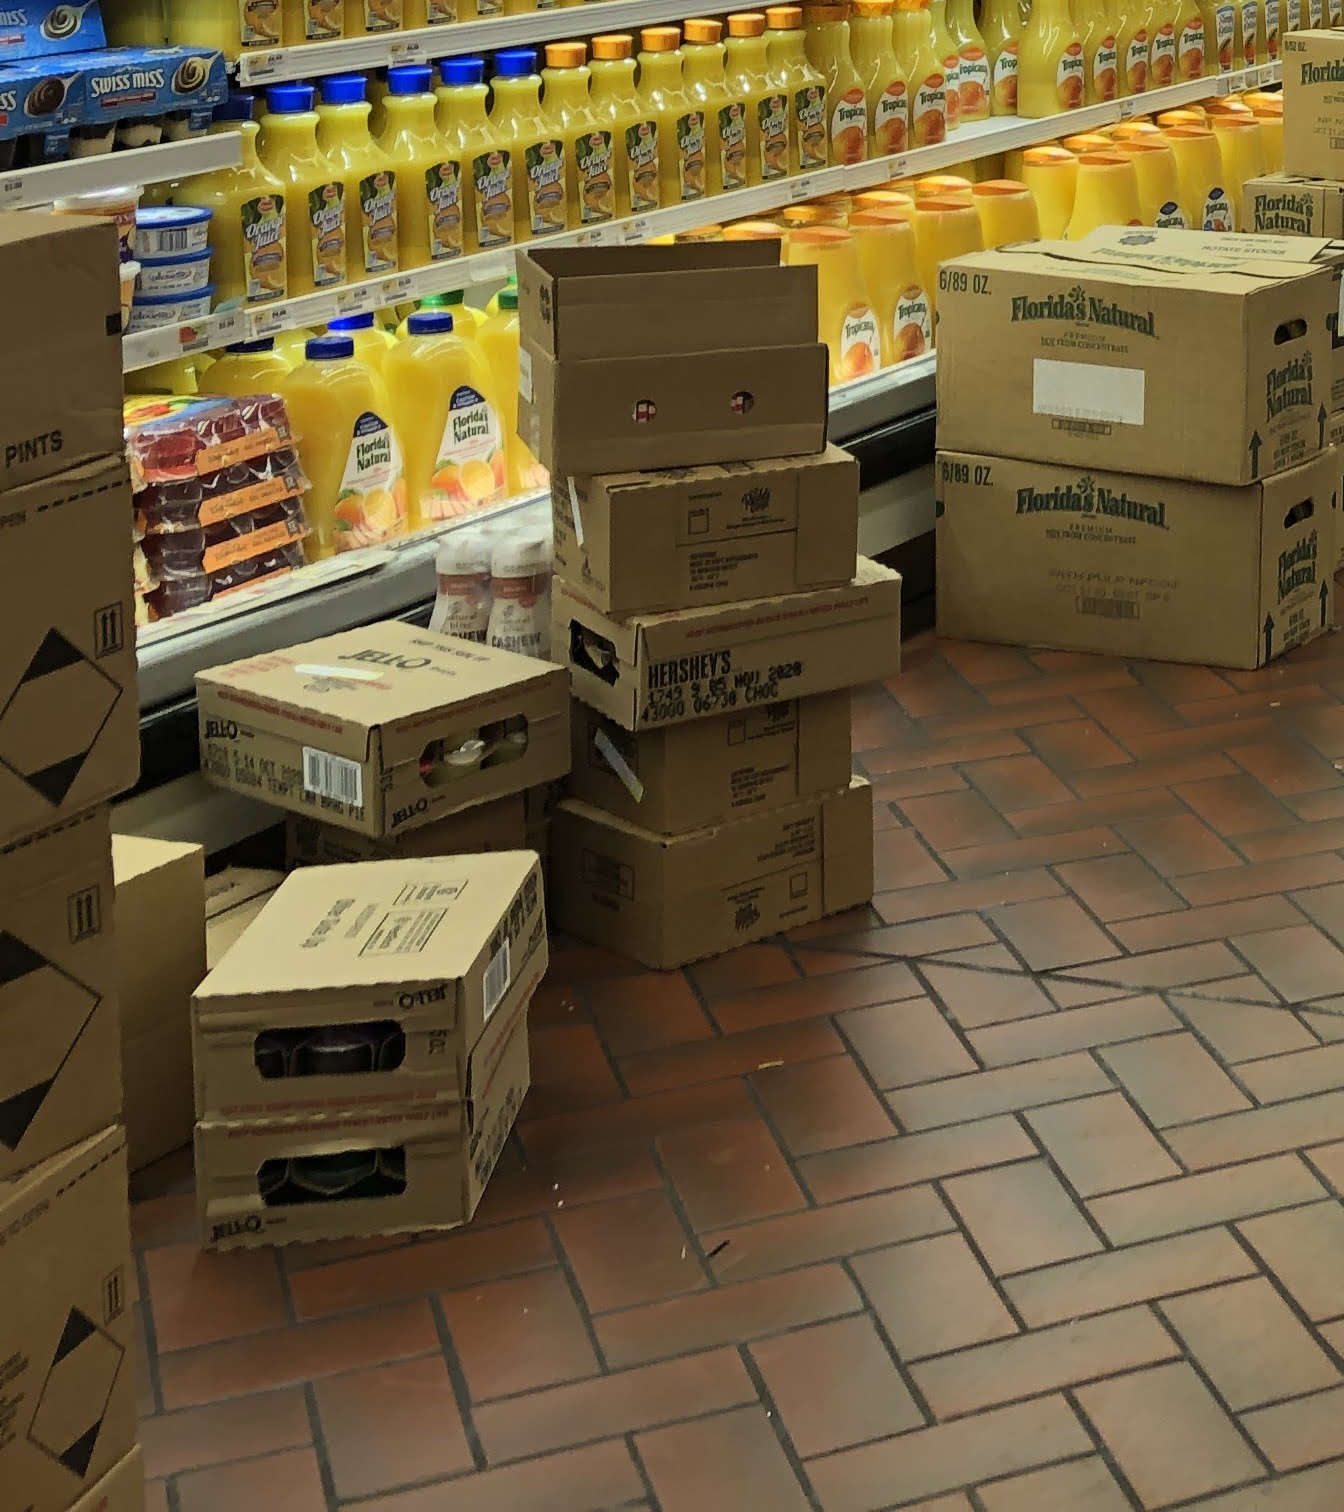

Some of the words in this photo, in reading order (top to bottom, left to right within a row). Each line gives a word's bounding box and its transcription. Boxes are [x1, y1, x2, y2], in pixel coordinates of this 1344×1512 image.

[91, 74, 130, 97] SWISS
[1254, 194, 1313, 217] Florida's
[1254, 213, 1312, 235] Natural
[939, 270, 970, 294] 6/89
[973, 274, 992, 296] OZ.
[897, 301, 927, 322] Tropicana
[1011, 287, 1087, 323] Florida's
[845, 320, 875, 338] Tropicana
[1266, 361, 1313, 396] Florida's
[1266, 382, 1313, 423] Natural
[453, 422, 488, 445] Natural
[4, 430, 64, 468] PINTS
[941, 462, 970, 485] 6/89
[974, 466, 994, 488] OZ.
[1016, 488, 1095, 516] Florida's
[648, 649, 731, 688] HERSHEY'S
